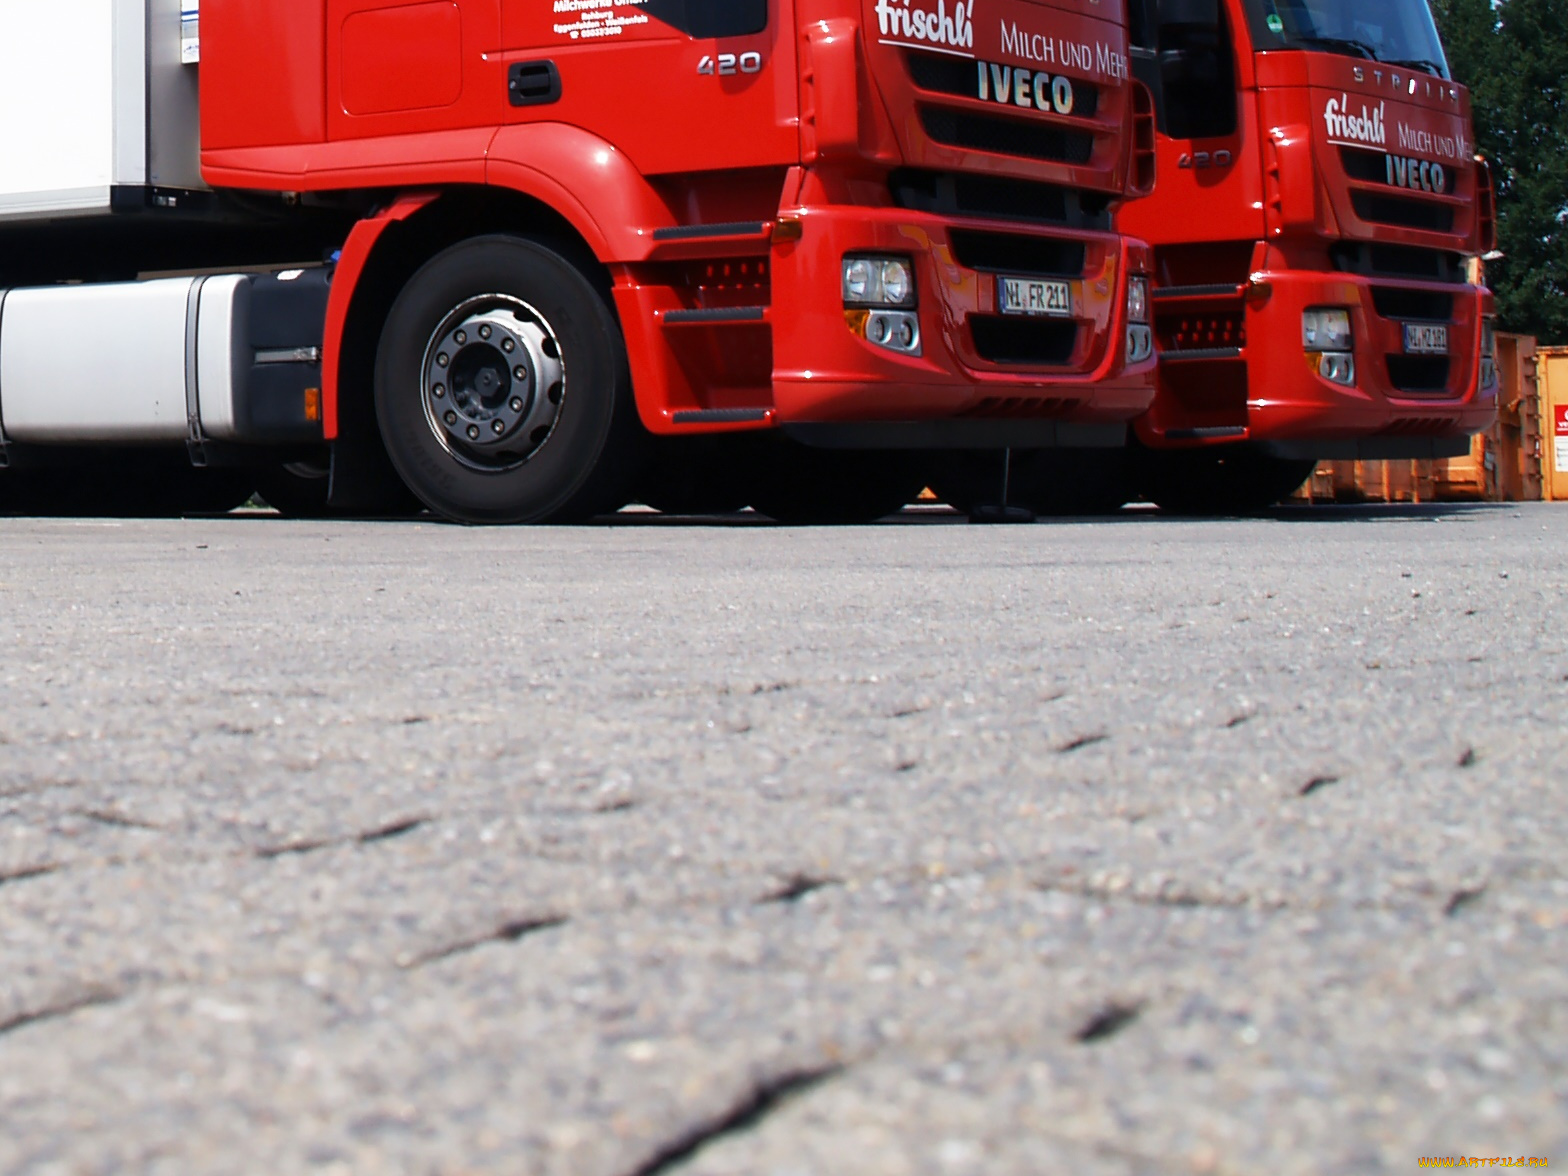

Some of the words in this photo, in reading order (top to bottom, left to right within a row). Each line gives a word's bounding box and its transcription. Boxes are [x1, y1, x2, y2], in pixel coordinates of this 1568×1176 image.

[697, 51, 762, 76] 420
[1001, 18, 1055, 64] MILCH
[1059, 39, 1092, 71] UND
[977, 61, 1074, 115] IVECO
[1323, 92, 1386, 144] frischli
[1398, 121, 1432, 153] MILCH
[1385, 154, 1445, 194] IVECO
[1005, 282, 1021, 307] NI
[1029, 283, 1045, 309] FR
[1047, 284, 1069, 310] 211
